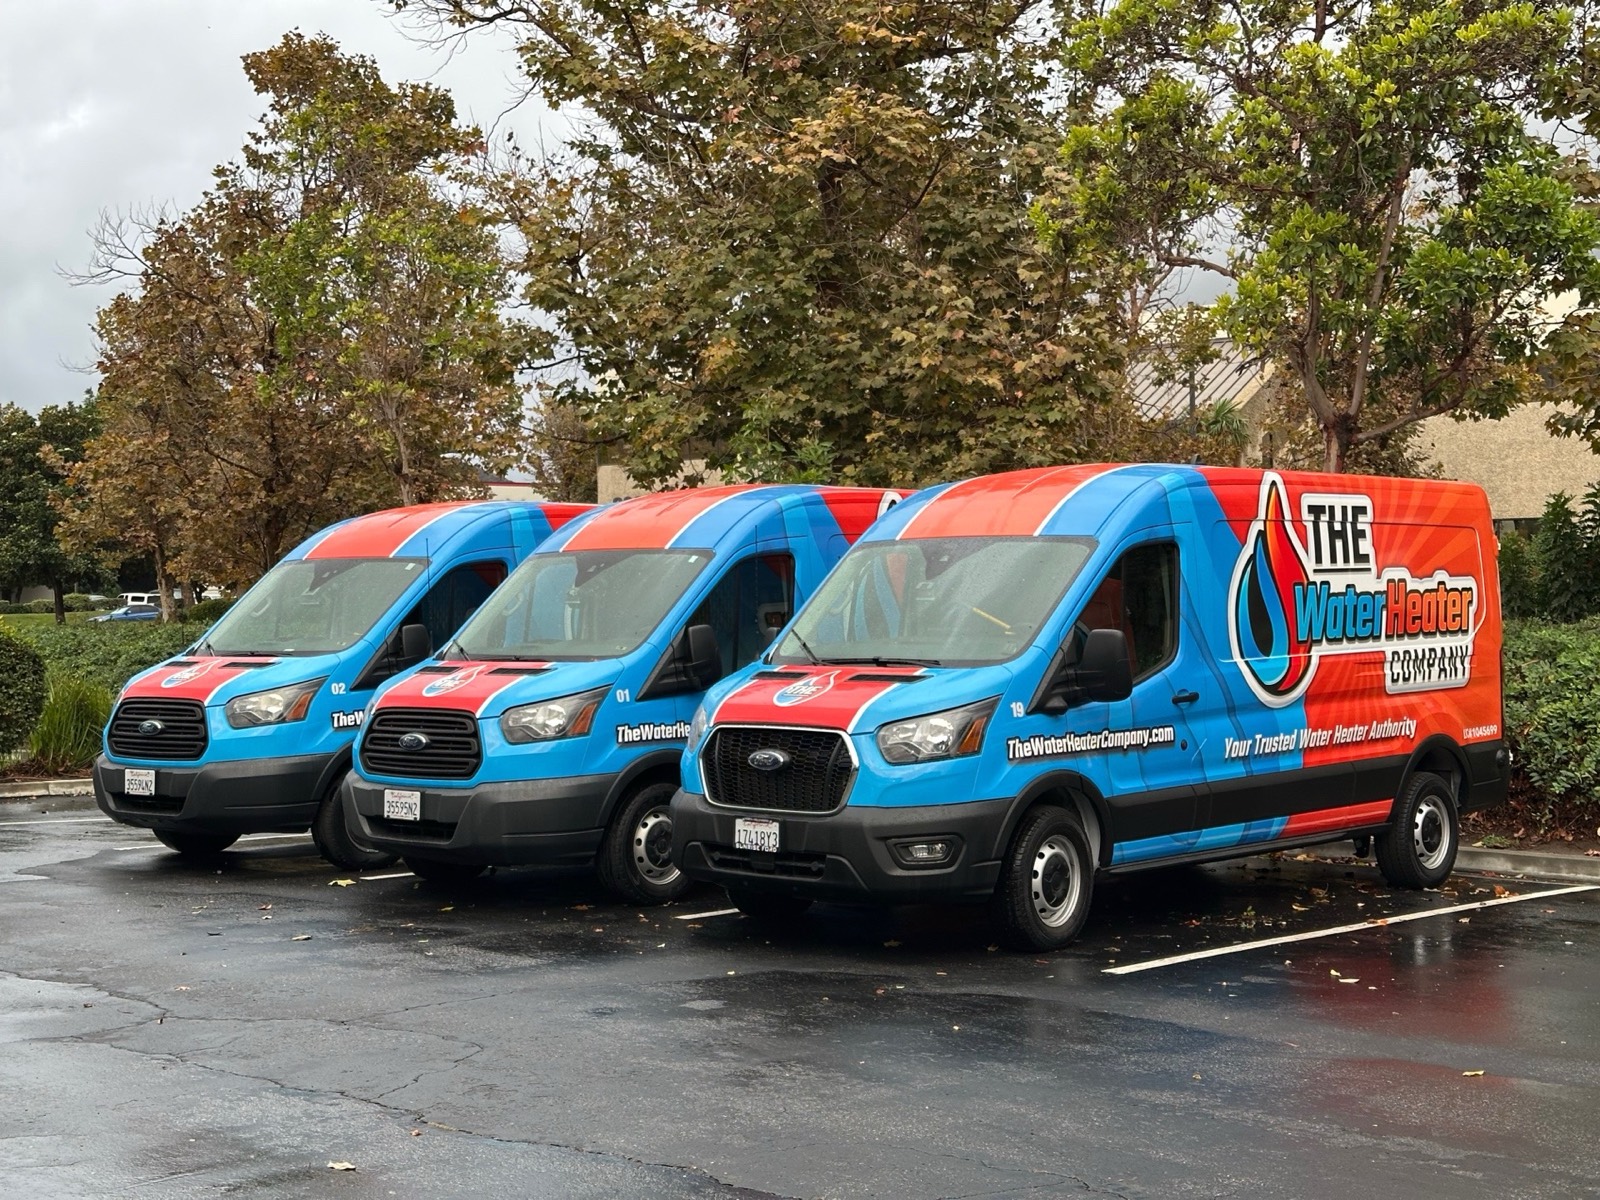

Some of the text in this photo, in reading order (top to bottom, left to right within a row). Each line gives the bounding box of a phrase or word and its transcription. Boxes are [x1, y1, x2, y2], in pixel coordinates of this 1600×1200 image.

[1307, 504, 1371, 565] THE
[1390, 645, 1469, 683] COMPANY
[331, 682, 346, 695] 02
[616, 689, 630, 703] 01
[1010, 702, 1025, 717] 19
[1007, 726, 1174, 759] TheWaterHeaterCompany.com
[1225, 716, 1417, 759] Your Trusted Water Heater Authority
[386, 800, 418, 816] 35595N2
[738, 829, 778, 848] 17418Y3
